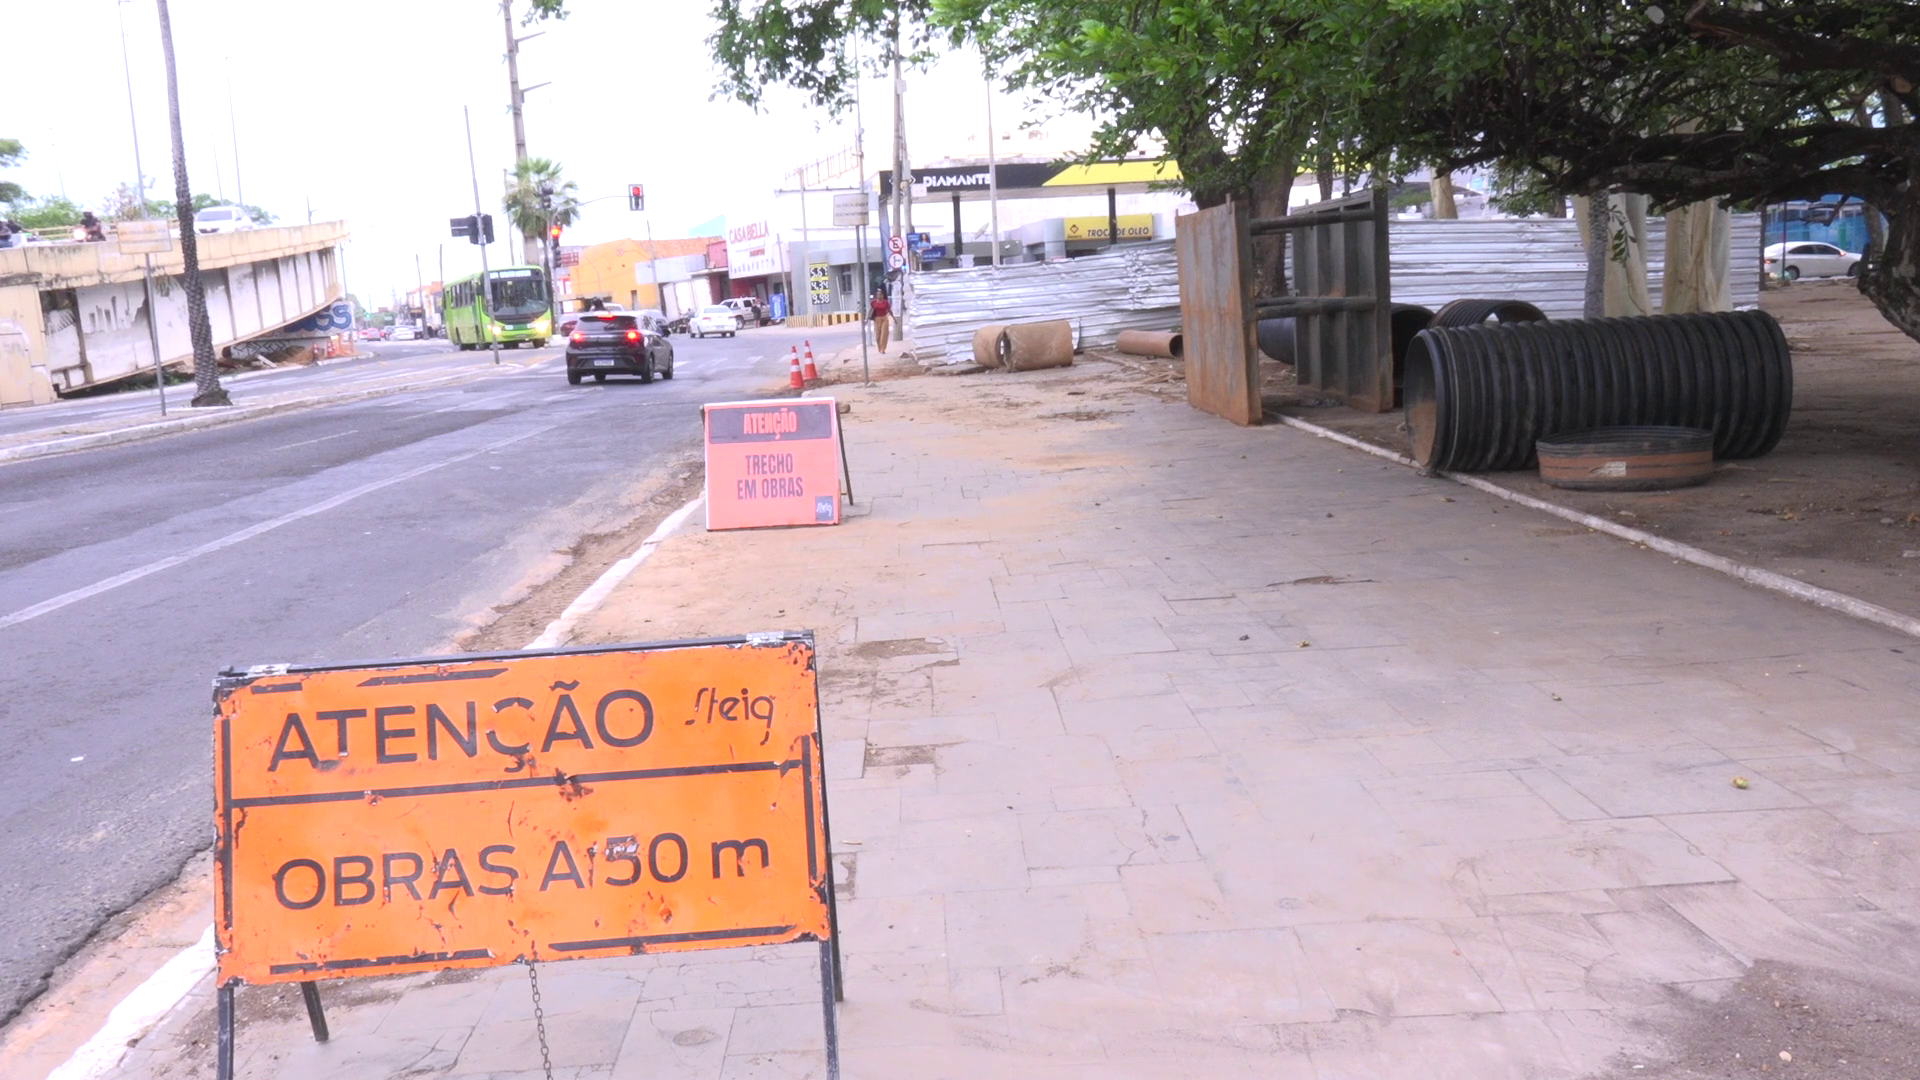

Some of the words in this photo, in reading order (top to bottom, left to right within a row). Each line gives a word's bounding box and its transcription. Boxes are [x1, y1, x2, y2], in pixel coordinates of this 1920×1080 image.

[1087, 228, 1110, 237] TROC
[743, 408, 798, 440] ATENÇÃO
[745, 453, 794, 475] TRECHO
[737, 478, 757, 500] EM
[762, 476, 804, 499] OBRAS
[267, 679, 655, 773] ATENÇÃO
[274, 843, 519, 911] OBRAS
[538, 840, 585, 892] A
[710, 837, 770, 879] m
